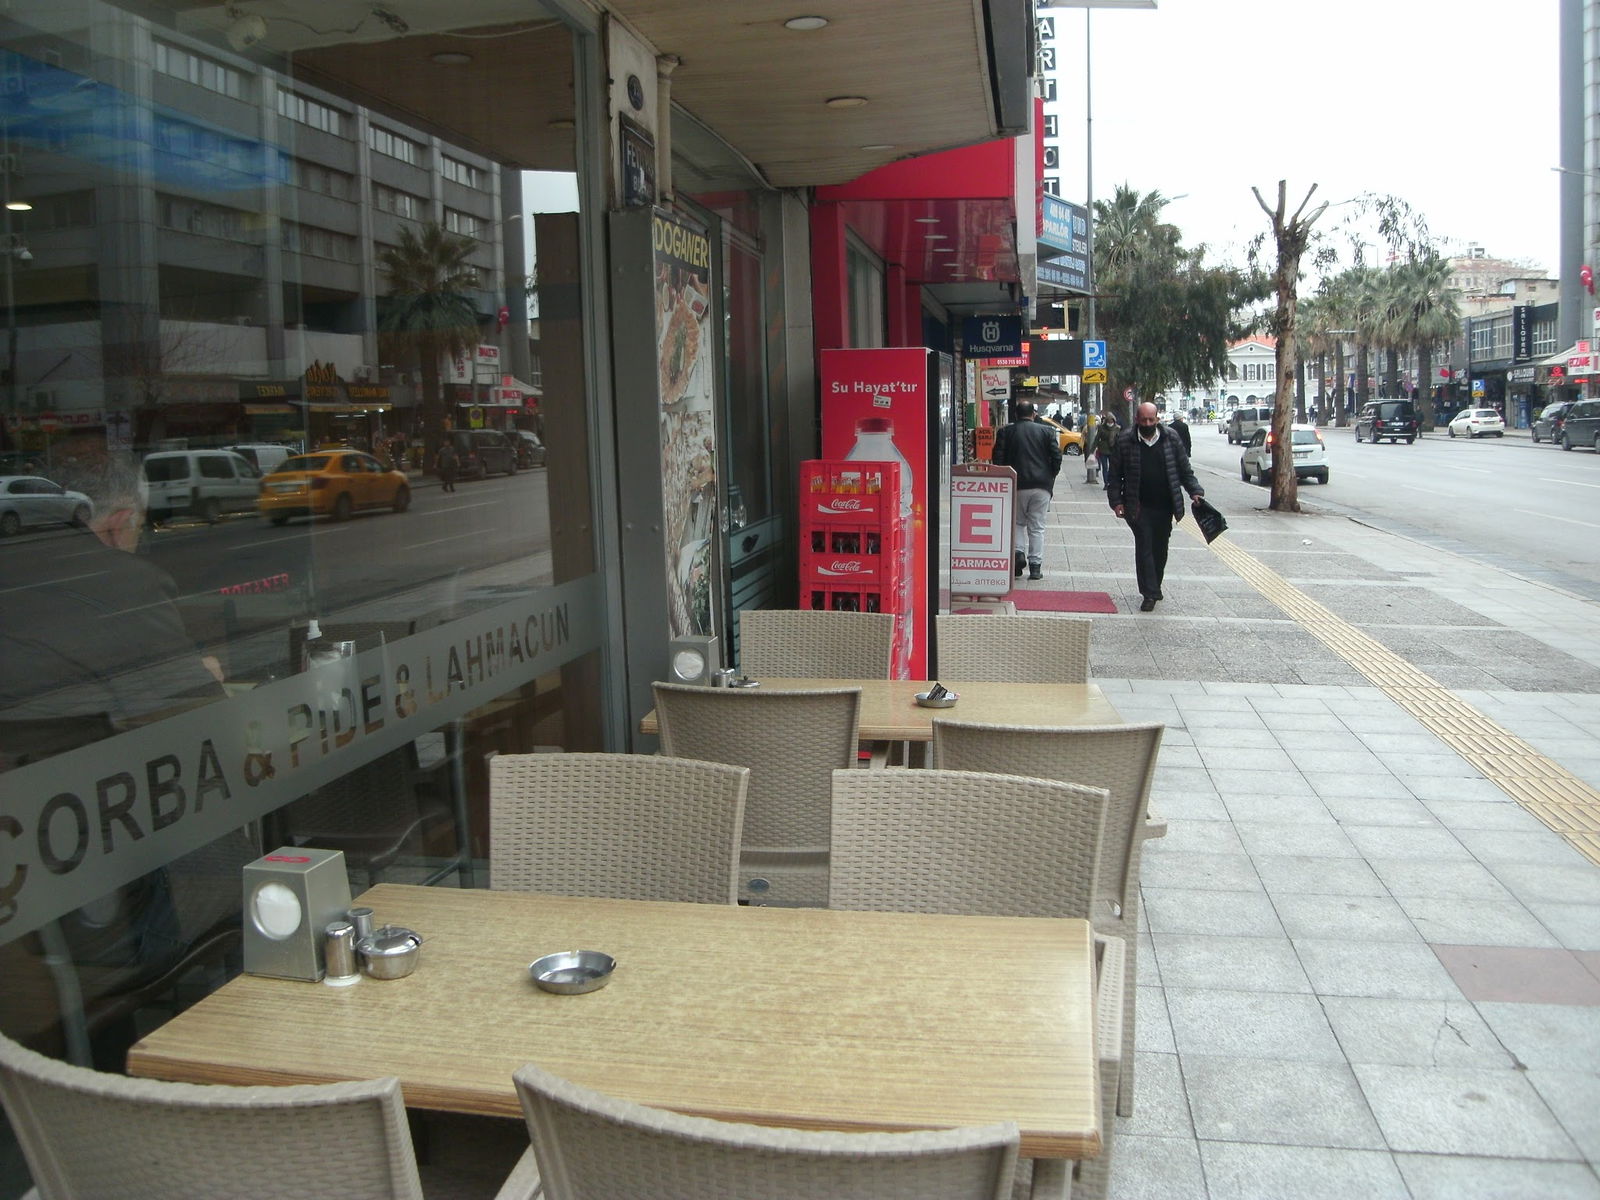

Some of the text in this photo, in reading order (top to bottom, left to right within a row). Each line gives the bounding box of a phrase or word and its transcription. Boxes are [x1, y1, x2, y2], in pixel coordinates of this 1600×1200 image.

[654, 217, 708, 268] DOĞANER
[969, 344, 1014, 354] Husqvarna
[1085, 343, 1099, 366] P
[832, 381, 918, 396] Su Hayat'tır
[959, 504, 993, 544] E
[974, 577, 1006, 586] аптека
[425, 603, 569, 705] LAHMACUN
